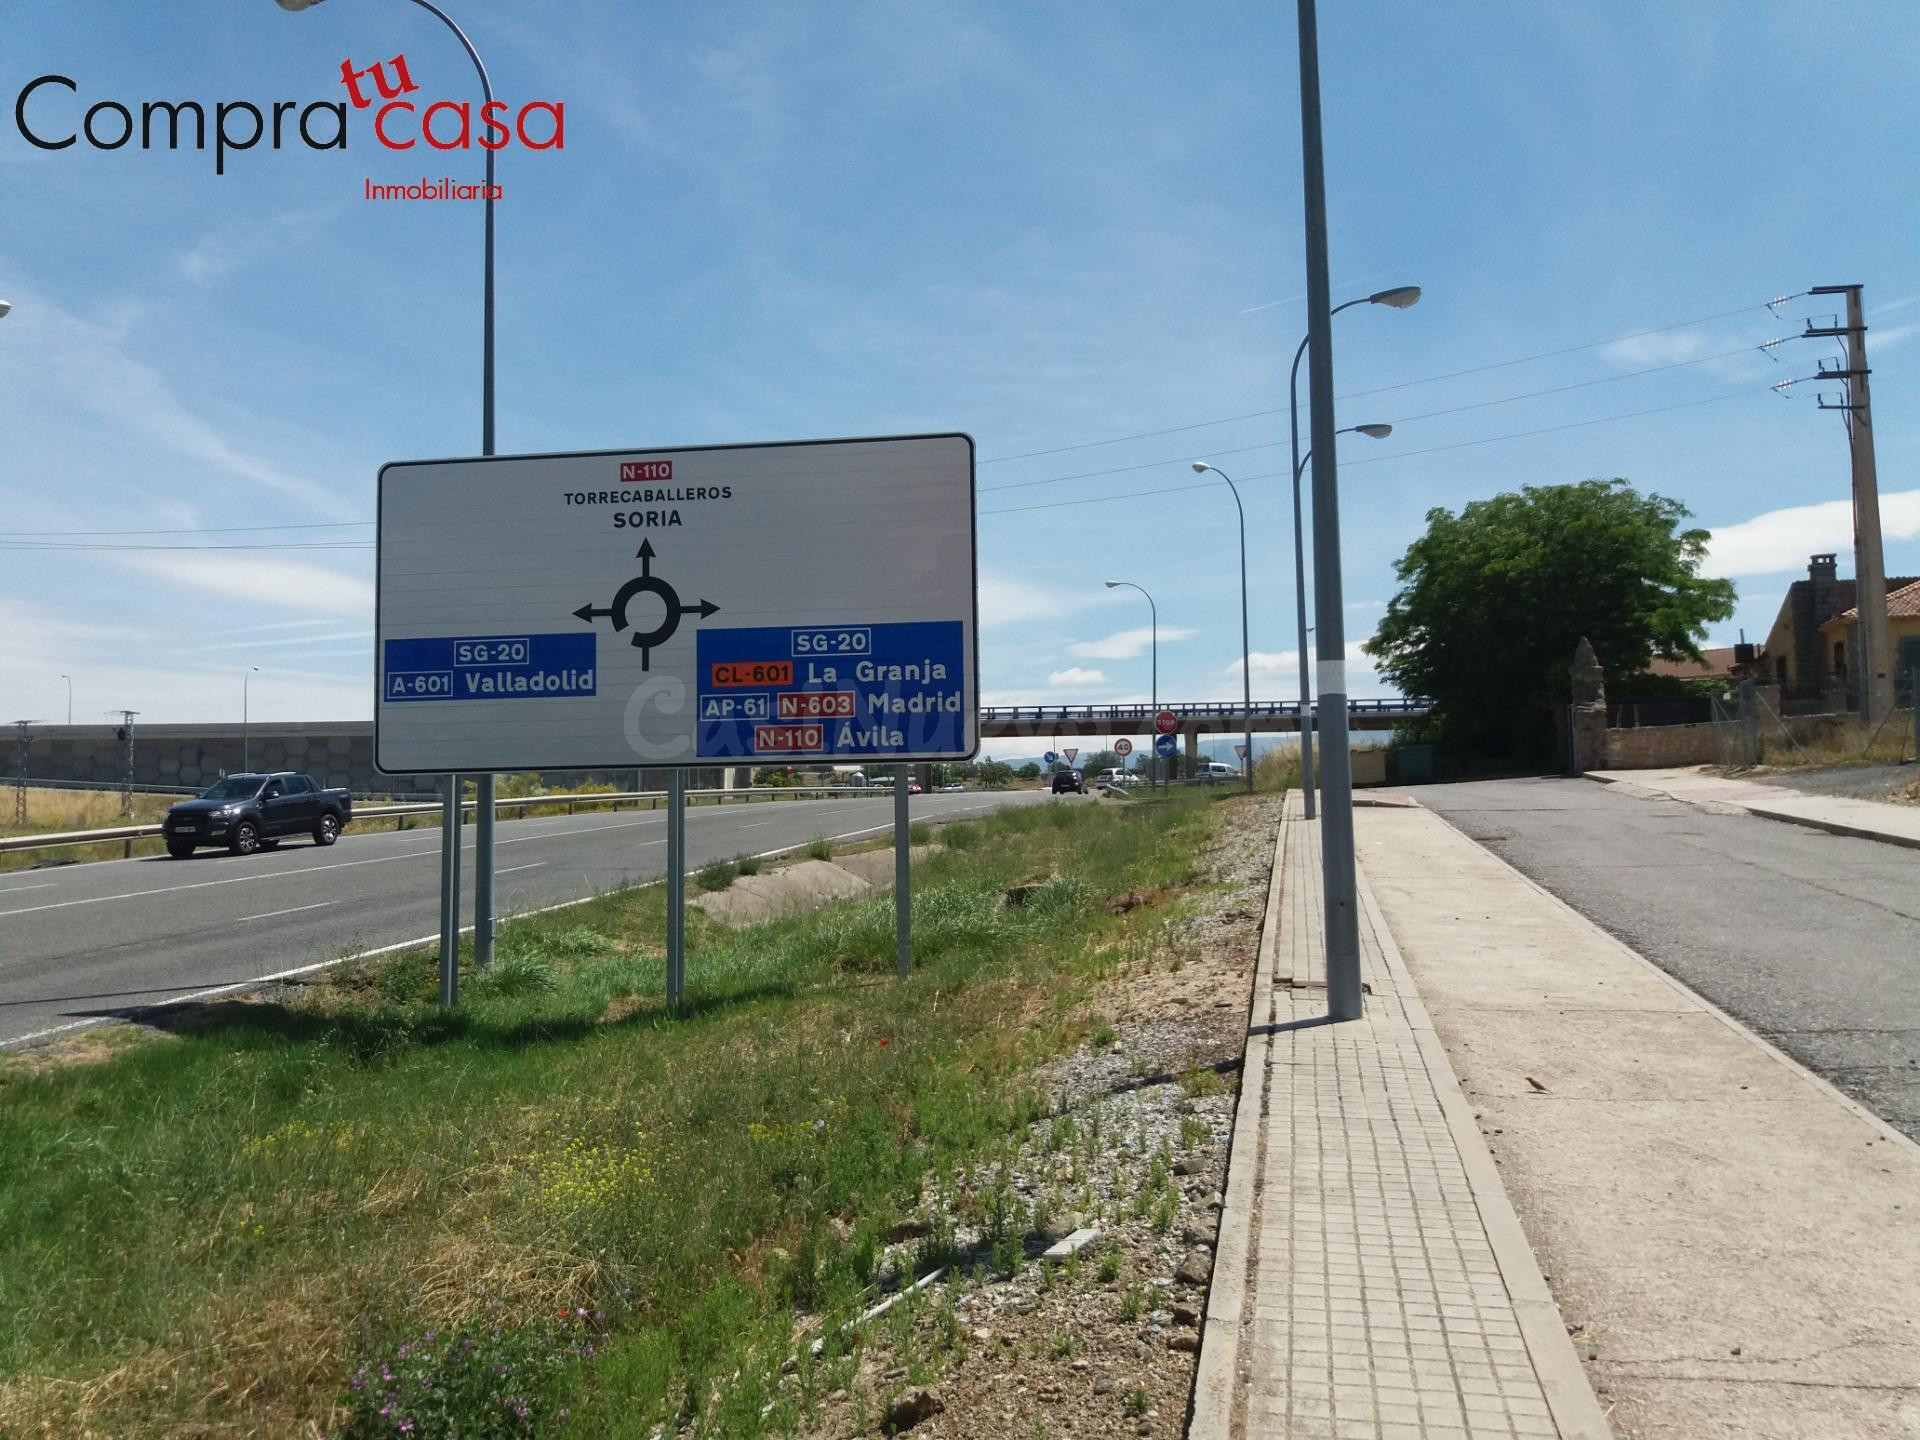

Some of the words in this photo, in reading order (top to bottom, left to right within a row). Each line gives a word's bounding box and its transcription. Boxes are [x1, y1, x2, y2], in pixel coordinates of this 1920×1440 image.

[622, 463, 670, 480] N-110
[564, 486, 732, 505] TORRECABALLEROS
[613, 510, 682, 528] SORIA
[458, 643, 525, 661] SG-20
[796, 634, 866, 652] SG-20
[391, 675, 450, 694] A-601
[466, 669, 593, 693] Valladolid
[714, 665, 790, 683] CL-601
[808, 662, 837, 684] La
[855, 660, 947, 685] Granja
[705, 698, 766, 717] AP-61
[781, 695, 851, 714] N-603
[868, 691, 961, 713] Madrid
[759, 730, 819, 748] N-110
[836, 723, 904, 748] Ávila
[1118, 743, 1129, 751] 40
